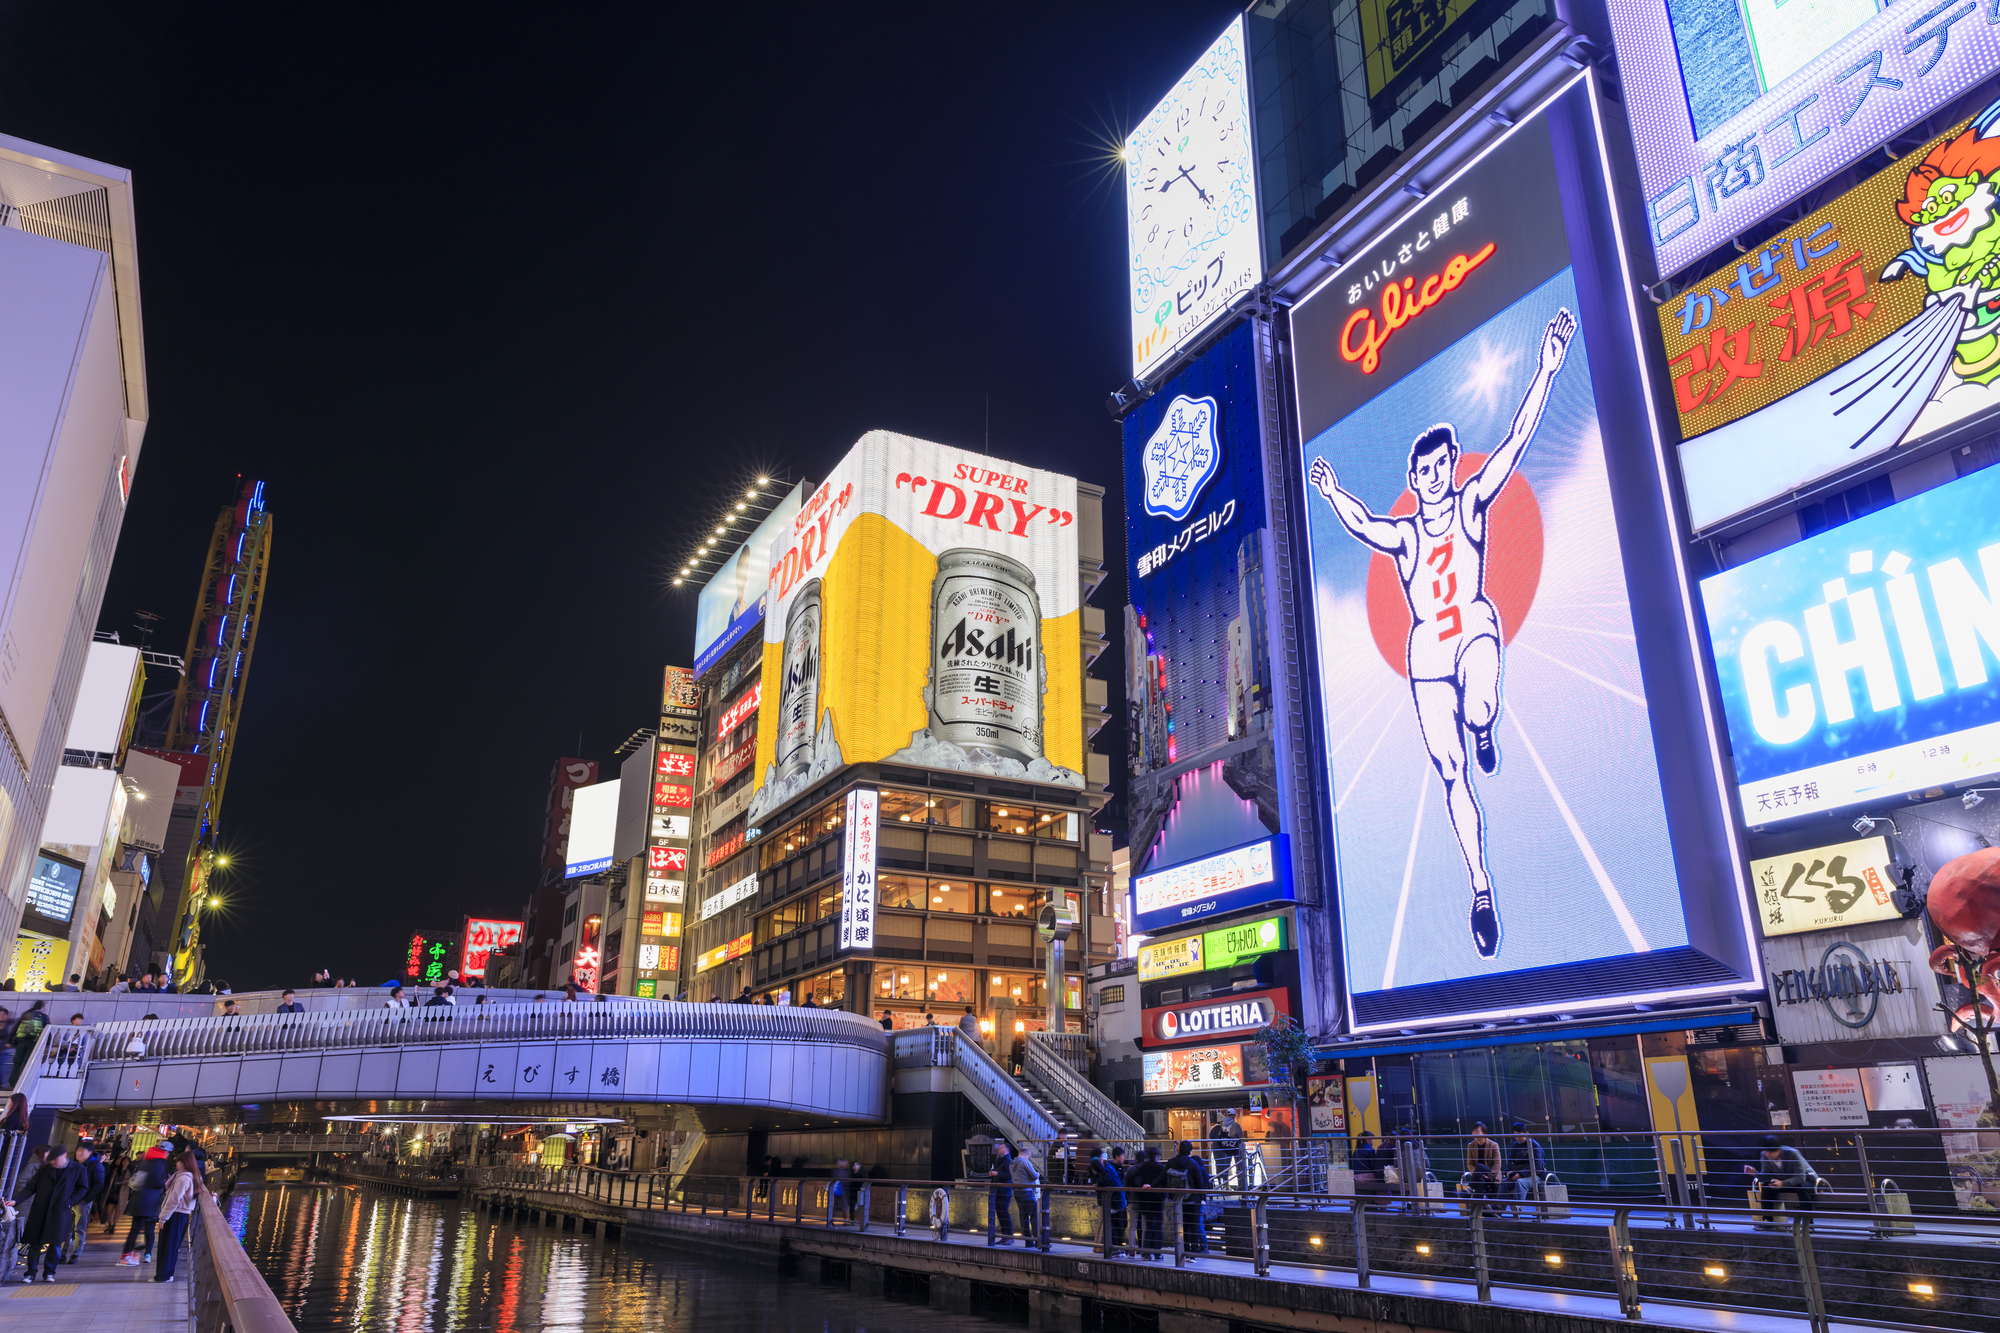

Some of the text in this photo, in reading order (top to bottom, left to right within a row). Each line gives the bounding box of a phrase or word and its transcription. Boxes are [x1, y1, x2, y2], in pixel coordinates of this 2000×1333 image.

[1348, 197, 1470, 305] おいしさと健康
[1177, 251, 1226, 316] ピップ
[1675, 221, 1840, 335] かぜに
[1178, 315, 1202, 339] Feb.
[1221, 267, 1252, 301] 2018
[1339, 242, 1497, 374] Glico
[1668, 249, 1877, 414] 改源
[953, 463, 1029, 495] SUPER
[793, 482, 830, 537] SUPER
[1137, 499, 1236, 578] 雪印メグミルク
[1426, 533, 1463, 642] グリコ
[952, 587, 1023, 621] ASAHI BREWERIES LIMITED
[941, 616, 1033, 673] Asahi
[782, 645, 818, 708] Asahi
[974, 675, 1001, 696] 生
[792, 703, 804, 724] 生
[961, 696, 1015, 713] スーパードライ
[660, 744, 673, 752] 8F
[976, 727, 999, 739] 350ml
[655, 792, 692, 806] ダイニング
[1756, 781, 1820, 812] 天気予報
[658, 838, 669, 846] 5F
[859, 814, 872, 865] 本場の味
[649, 870, 662, 878] 4F
[651, 849, 686, 869] はや
[1163, 857, 1237, 887] ようこそ道頓堀へ
[648, 882, 681, 897] 白木屋
[1761, 865, 1784, 926] 道頓堀
[1780, 855, 1866, 914] くくる
[645, 903, 659, 911] 3F
[855, 869, 872, 942] かに道楽
[1814, 915, 1844, 925] KUKURU
[471, 925, 518, 948] かに
[426, 942, 446, 978] 千房
[640, 970, 653, 978] 1F
[1116, 960, 1133, 970] Toilets
[1771, 957, 1903, 1008] PENGUIN BAR
[1180, 1001, 1264, 1032] LOTTERIA
[482, 1064, 620, 1087] えびす橋
[1167, 1052, 1175, 1091] TAKOYAKI
